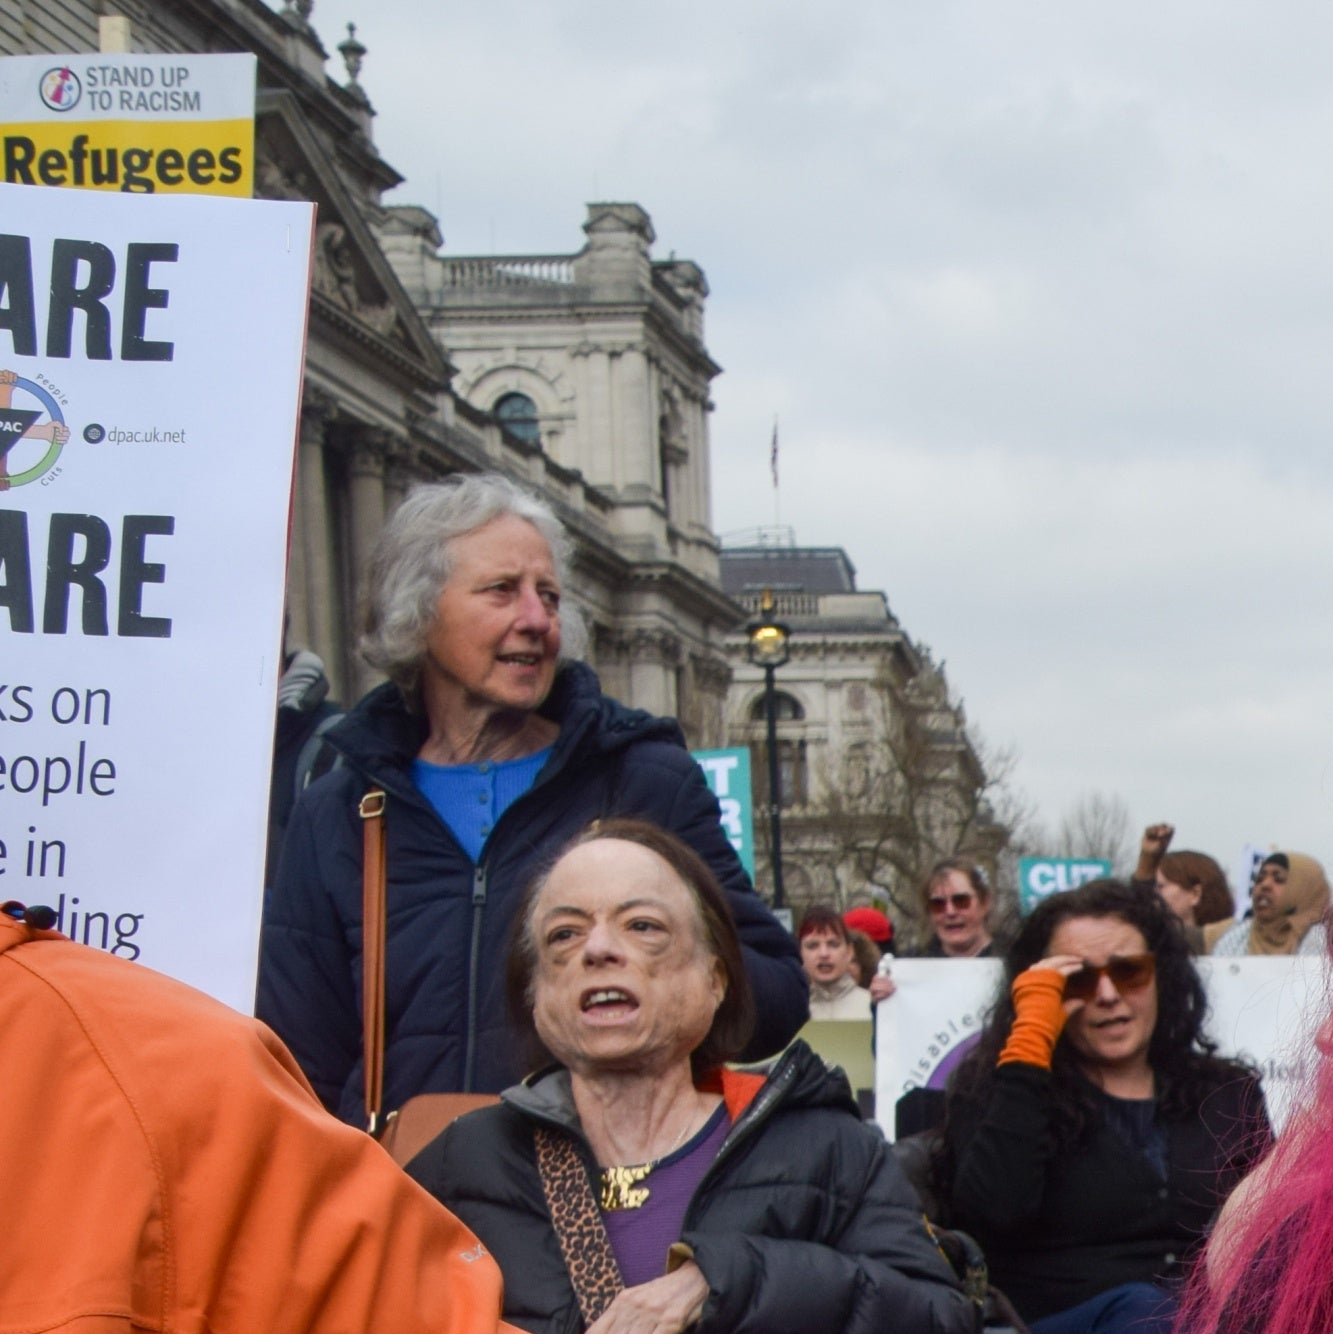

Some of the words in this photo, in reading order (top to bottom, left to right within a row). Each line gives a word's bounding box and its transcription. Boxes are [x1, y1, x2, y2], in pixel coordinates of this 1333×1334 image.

[87, 65, 154, 88] STAND
[161, 65, 189, 88] UP
[87, 90, 113, 112] TO
[119, 91, 201, 112] RACISM
[4, 133, 242, 194] Refugees
[0, 234, 179, 361] ARE
[107, 425, 186, 445] dpac.uk.net
[0, 510, 175, 637] ARE
[52, 687, 111, 726] on
[26, 826, 66, 878] in
[1028, 862, 1104, 896] CUT
